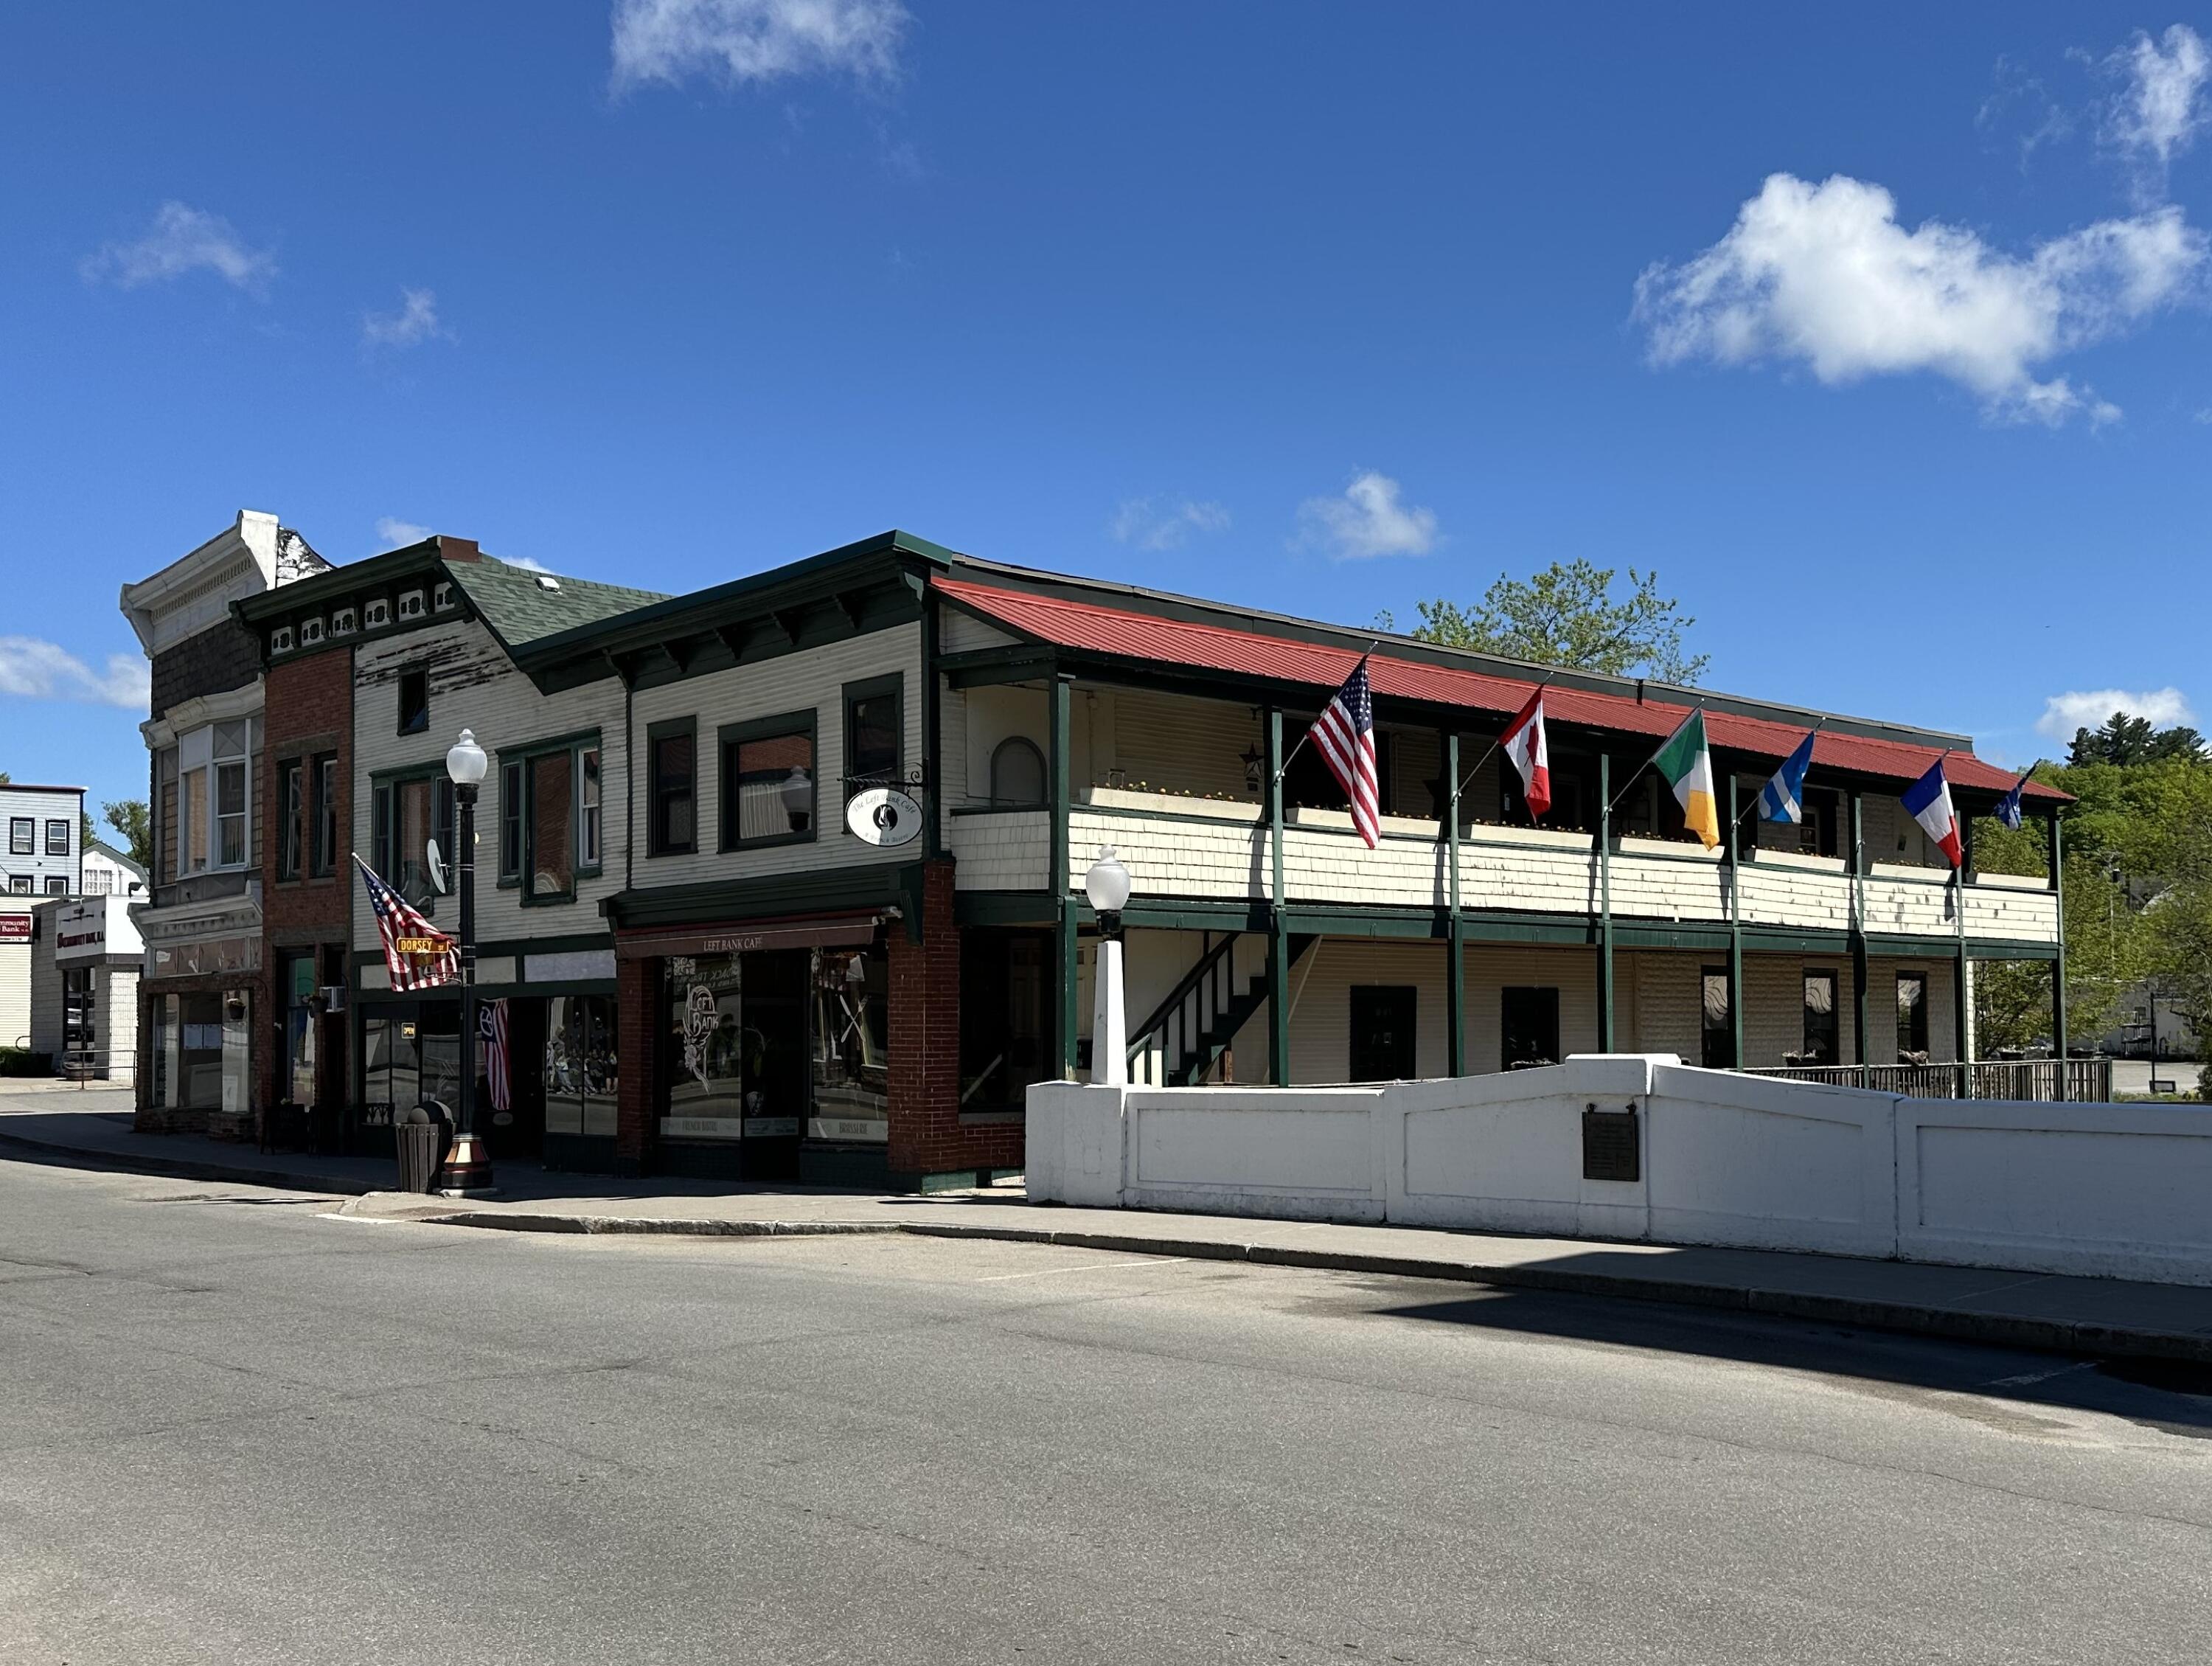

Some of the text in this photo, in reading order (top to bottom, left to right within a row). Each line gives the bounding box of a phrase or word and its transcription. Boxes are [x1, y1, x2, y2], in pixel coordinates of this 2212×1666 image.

[400, 940, 432, 951] DORSEY
[703, 940, 720, 951] LEFT
[722, 938, 742, 951] BANK
